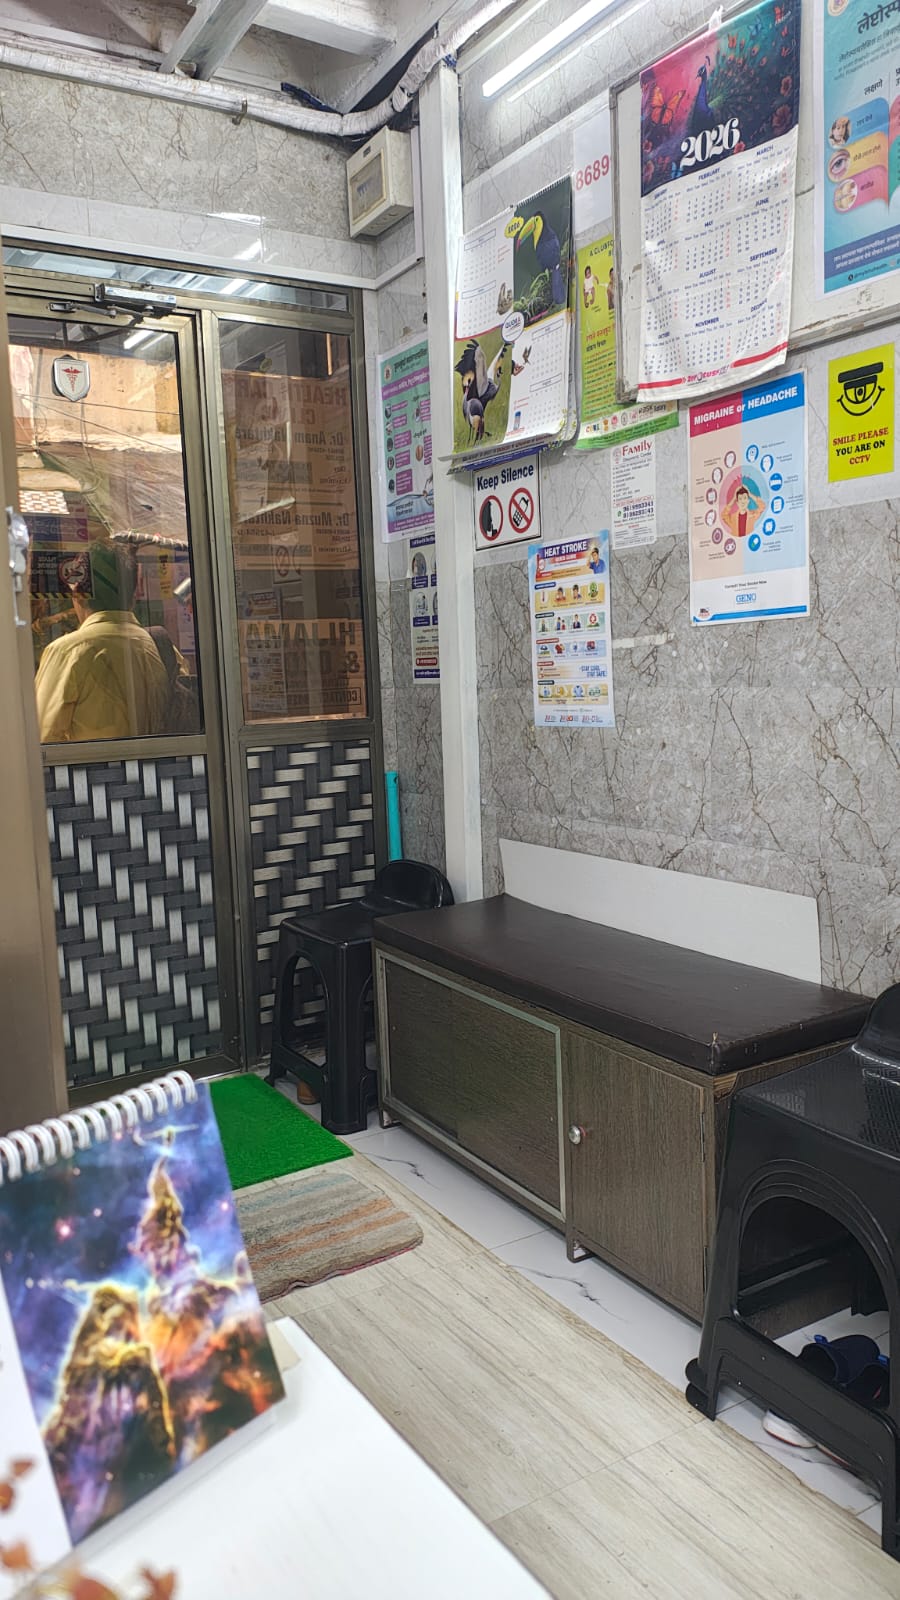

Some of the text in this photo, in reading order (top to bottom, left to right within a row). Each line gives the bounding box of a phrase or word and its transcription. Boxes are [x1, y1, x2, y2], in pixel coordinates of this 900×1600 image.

[680, 118, 740, 168] 2026
[756, 145, 774, 156] MARCH
[575, 154, 610, 191] 8689
[698, 167, 720, 181] FEBRUARY
[755, 197, 769, 207] JUNE
[749, 248, 778, 262] SEPTEMBER
[699, 268, 717, 279] AUGUST
[695, 316, 719, 328] NOVEMBER
[694, 386, 798, 425] MIGRAINE or HEADACHE
[832, 427, 889, 446] SMILE PLEASE
[836, 440, 885, 456] YOU ARE ON
[849, 454, 871, 464] CCTV
[477, 464, 534, 491] Keep Silence
[544, 541, 588, 558] HEAT STROKE
